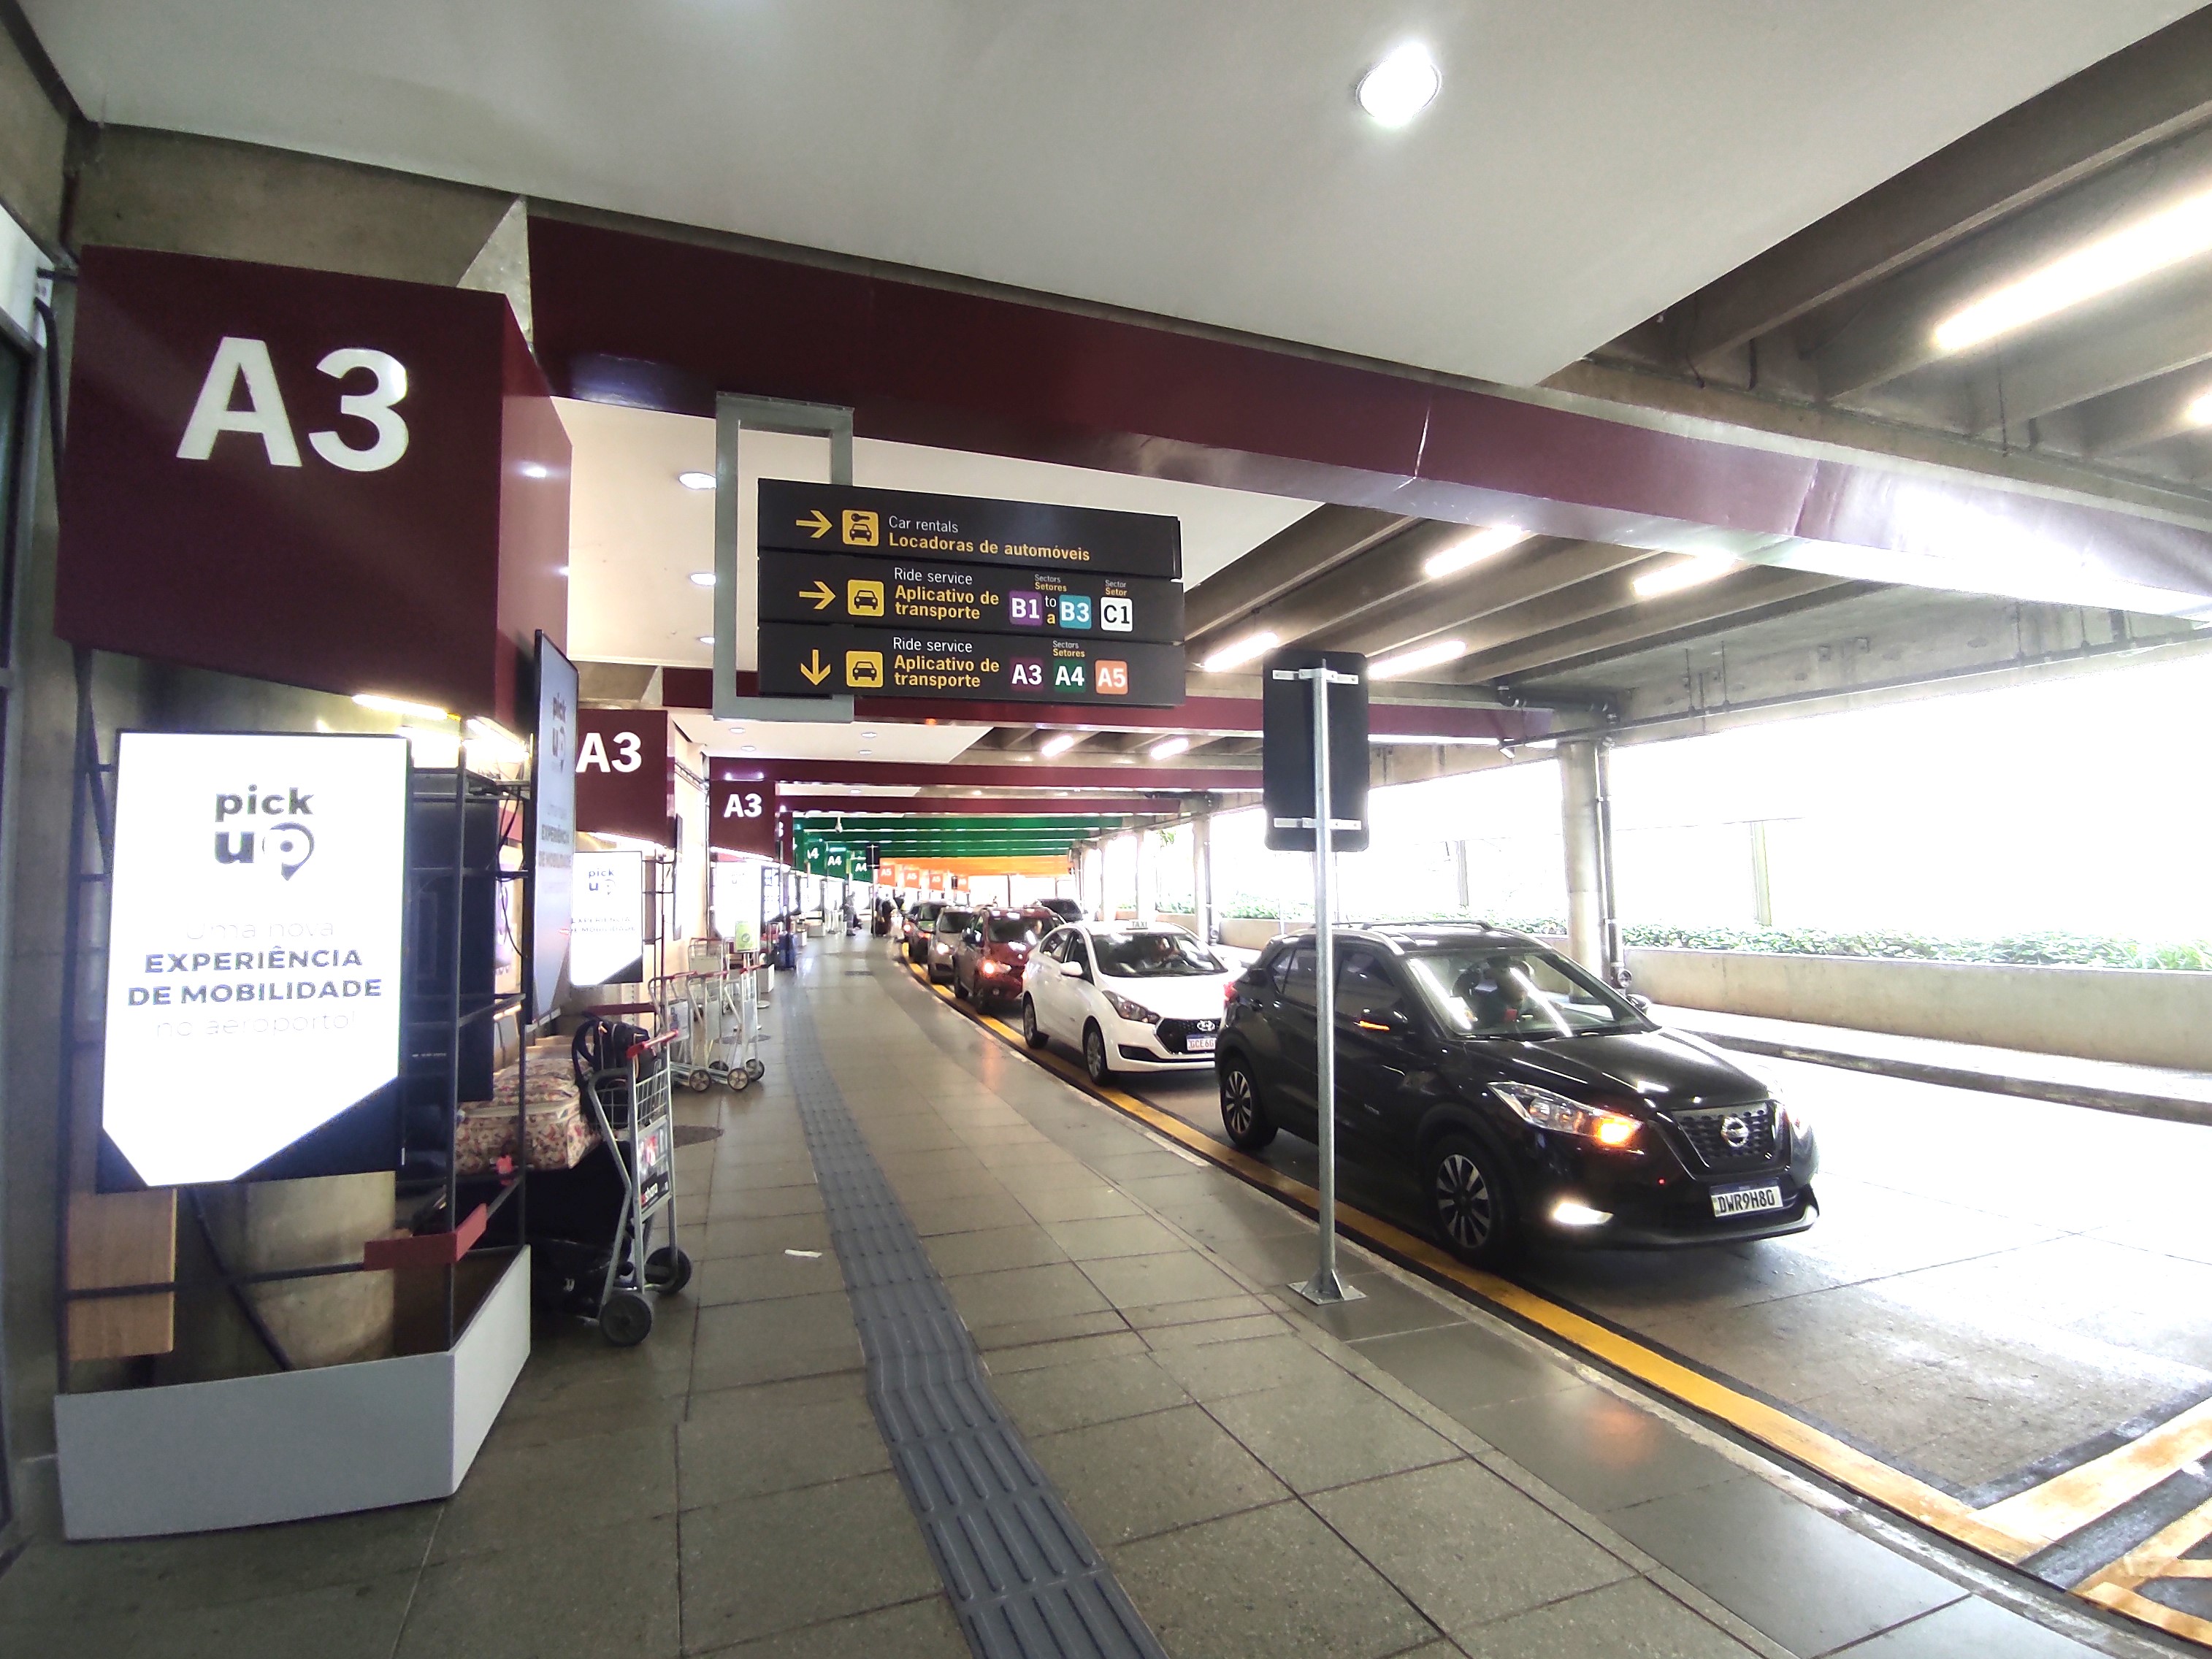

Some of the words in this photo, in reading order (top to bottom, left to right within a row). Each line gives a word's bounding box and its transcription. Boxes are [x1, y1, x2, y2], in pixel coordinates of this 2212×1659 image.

[176, 336, 409, 472] A3
[889, 516, 911, 529] Car
[916, 521, 958, 533] rentals
[889, 532, 973, 552] Locadoras
[980, 540, 998, 553] de
[1004, 543, 1090, 562] automóveis
[895, 567, 922, 581] Ride
[927, 572, 973, 584] service
[1035, 574, 1060, 583] Sectors
[1105, 580, 1127, 588] Sector
[895, 584, 974, 603] Aplicativo
[980, 591, 1000, 605] de
[1035, 582, 1067, 591] Setores
[1105, 587, 1128, 596] Setor
[895, 602, 980, 620] transporte
[1011, 597, 1040, 619] B1
[1045, 595, 1057, 608] to
[1061, 601, 1090, 622] B3
[1103, 605, 1130, 624] C1
[1046, 613, 1056, 624] a
[893, 637, 922, 651] Ride
[927, 640, 973, 653] service
[1052, 640, 1079, 649] Sectors
[1052, 648, 1085, 657] Setores
[894, 655, 974, 673] Aplicativo
[980, 658, 1000, 672] de
[894, 672, 981, 689] transporte
[1011, 664, 1042, 685] A3
[1055, 665, 1084, 686] A4
[1098, 667, 1126, 688] A5
[575, 732, 642, 773] A3
[215, 783, 315, 822] pick
[724, 793, 762, 818] A3
[827, 855, 842, 866] A4
[589, 868, 614, 878] pick
[881, 868, 892, 876] A5
[906, 873, 917, 881] A5
[186, 923, 256, 940] Uma
[269, 922, 333, 938] nova
[1132, 921, 1147, 929] TAXI
[145, 945, 363, 973] EXPERIÊNCIA
[128, 986, 172, 1006] DE
[181, 978, 382, 1004] MOBILIDADE
[157, 1022, 194, 1037] no
[1190, 1039, 1214, 1049] GCE6G
